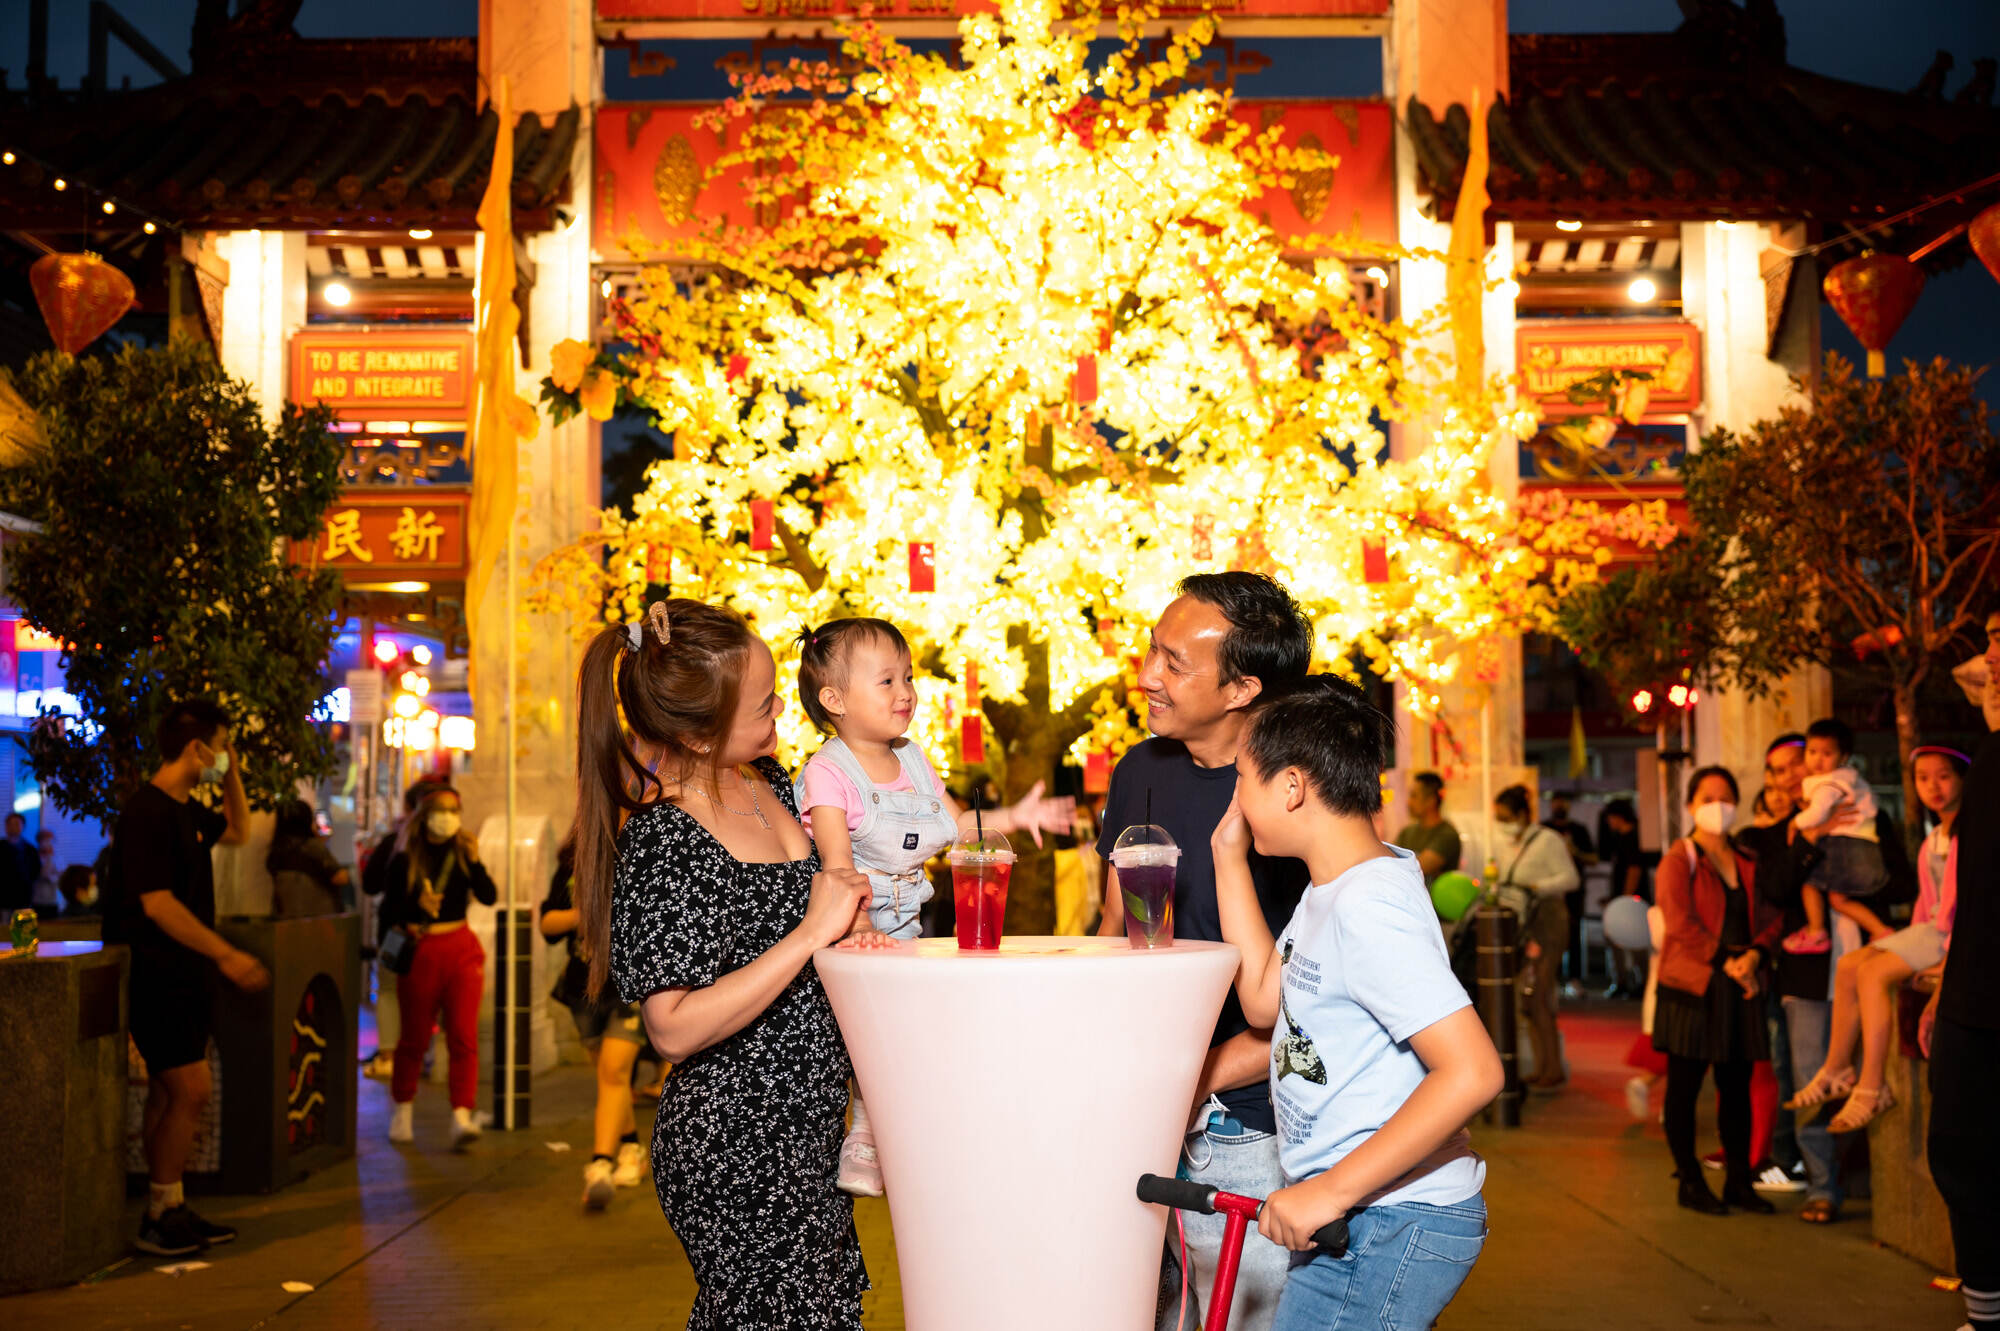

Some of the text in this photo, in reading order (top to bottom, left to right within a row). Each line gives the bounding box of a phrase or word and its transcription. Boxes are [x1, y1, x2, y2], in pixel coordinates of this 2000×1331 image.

[310, 351, 333, 372] TO
[337, 351, 361, 372] BE
[311, 376, 445, 398] AND INTEGRATE
